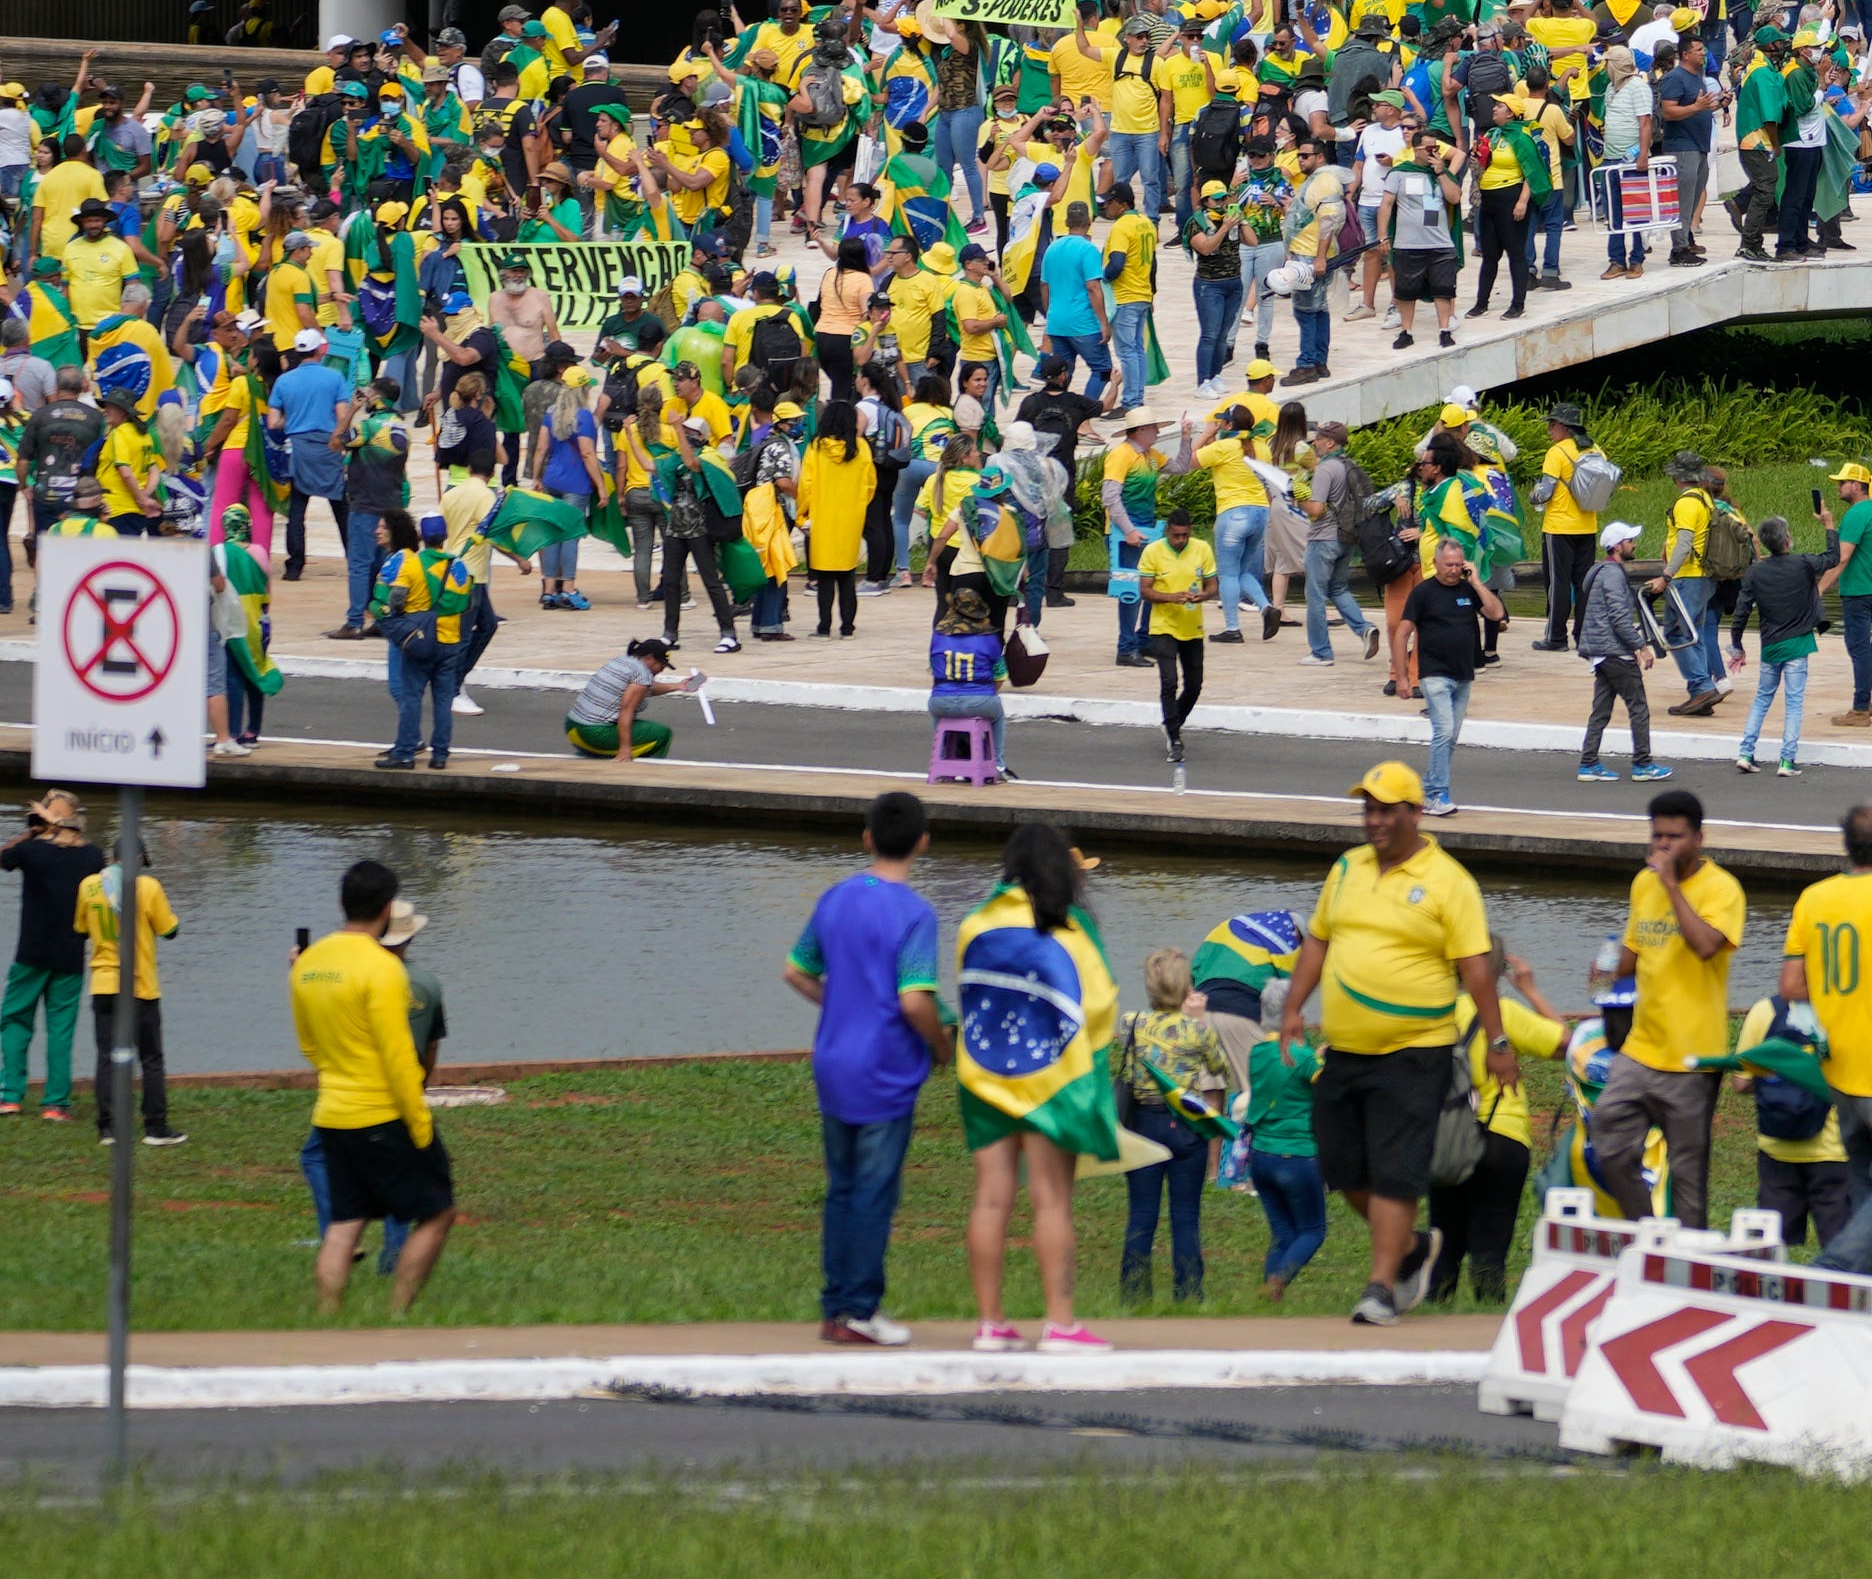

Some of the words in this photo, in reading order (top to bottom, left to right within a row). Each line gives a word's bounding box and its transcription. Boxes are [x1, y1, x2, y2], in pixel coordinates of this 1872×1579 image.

[1140, 232, 1155, 266] 10
[66, 724, 135, 753] INÍCIO
[1816, 922, 1861, 997] 10
